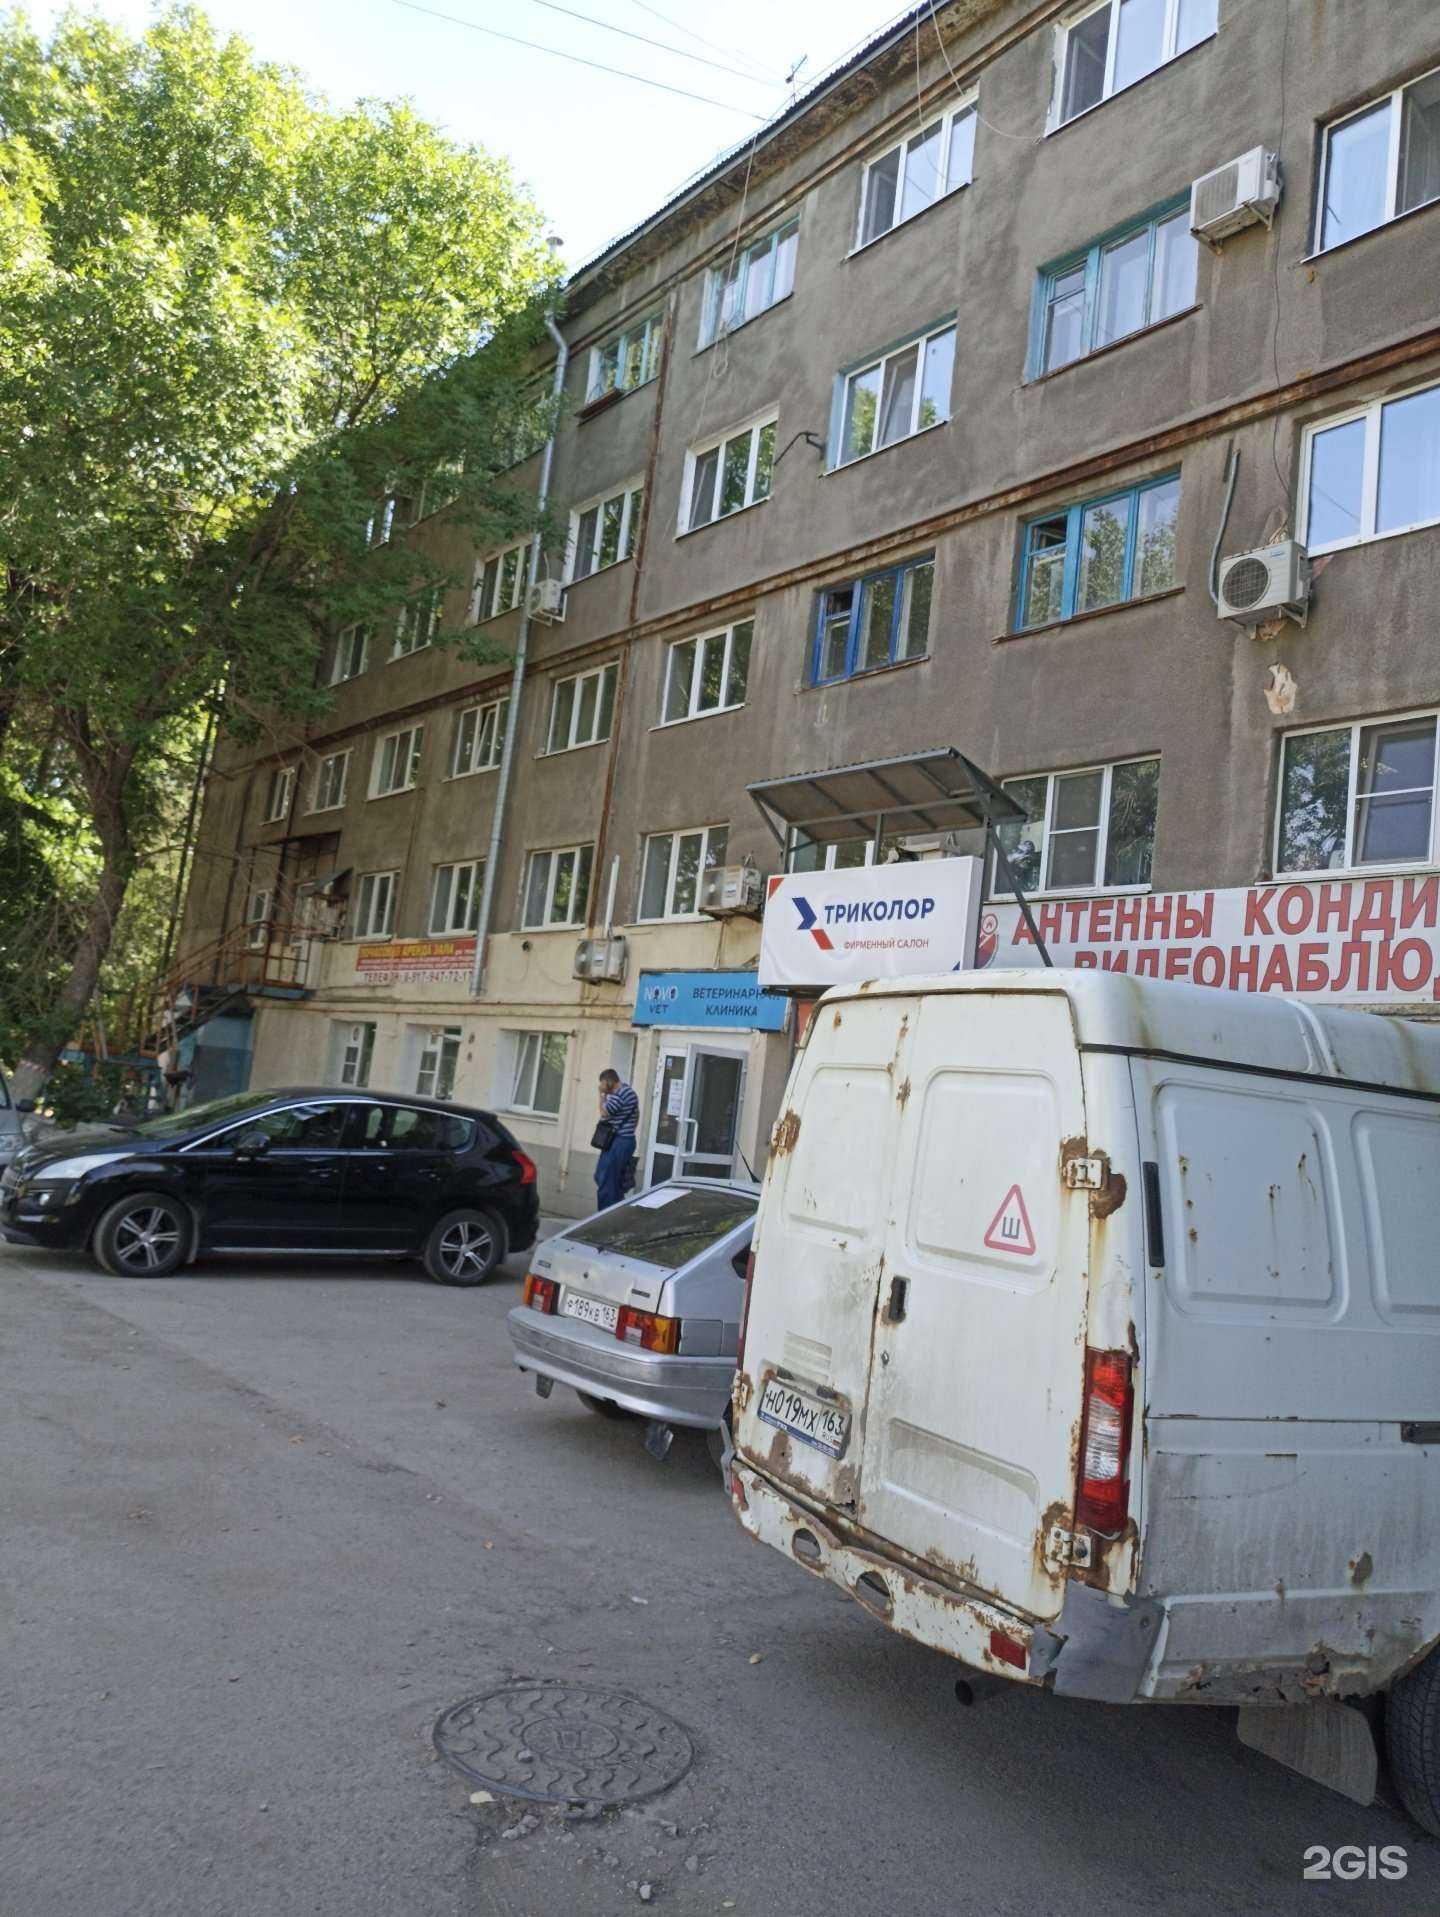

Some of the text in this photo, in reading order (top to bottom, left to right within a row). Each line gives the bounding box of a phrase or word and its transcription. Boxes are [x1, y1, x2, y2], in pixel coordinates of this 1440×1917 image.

[824, 897, 935, 925] ТРИКОЛОР
[1011, 876, 1440, 946] АНТЕННЫ КОНДИ
[843, 938, 929, 950] ФИРМЕННЫЙ САЛОН
[1074, 937, 1440, 1000] ЕОНАБЛЮ
[692, 987, 780, 1000] ВЕТЕРИНАРН
[650, 1004, 669, 1014] VET
[705, 1004, 758, 1016] КЛИНИКА
[1001, 1216, 1021, 1240] Ш
[602, 1306, 616, 1323] 163
[766, 1389, 845, 1436] Н019МХ 163
